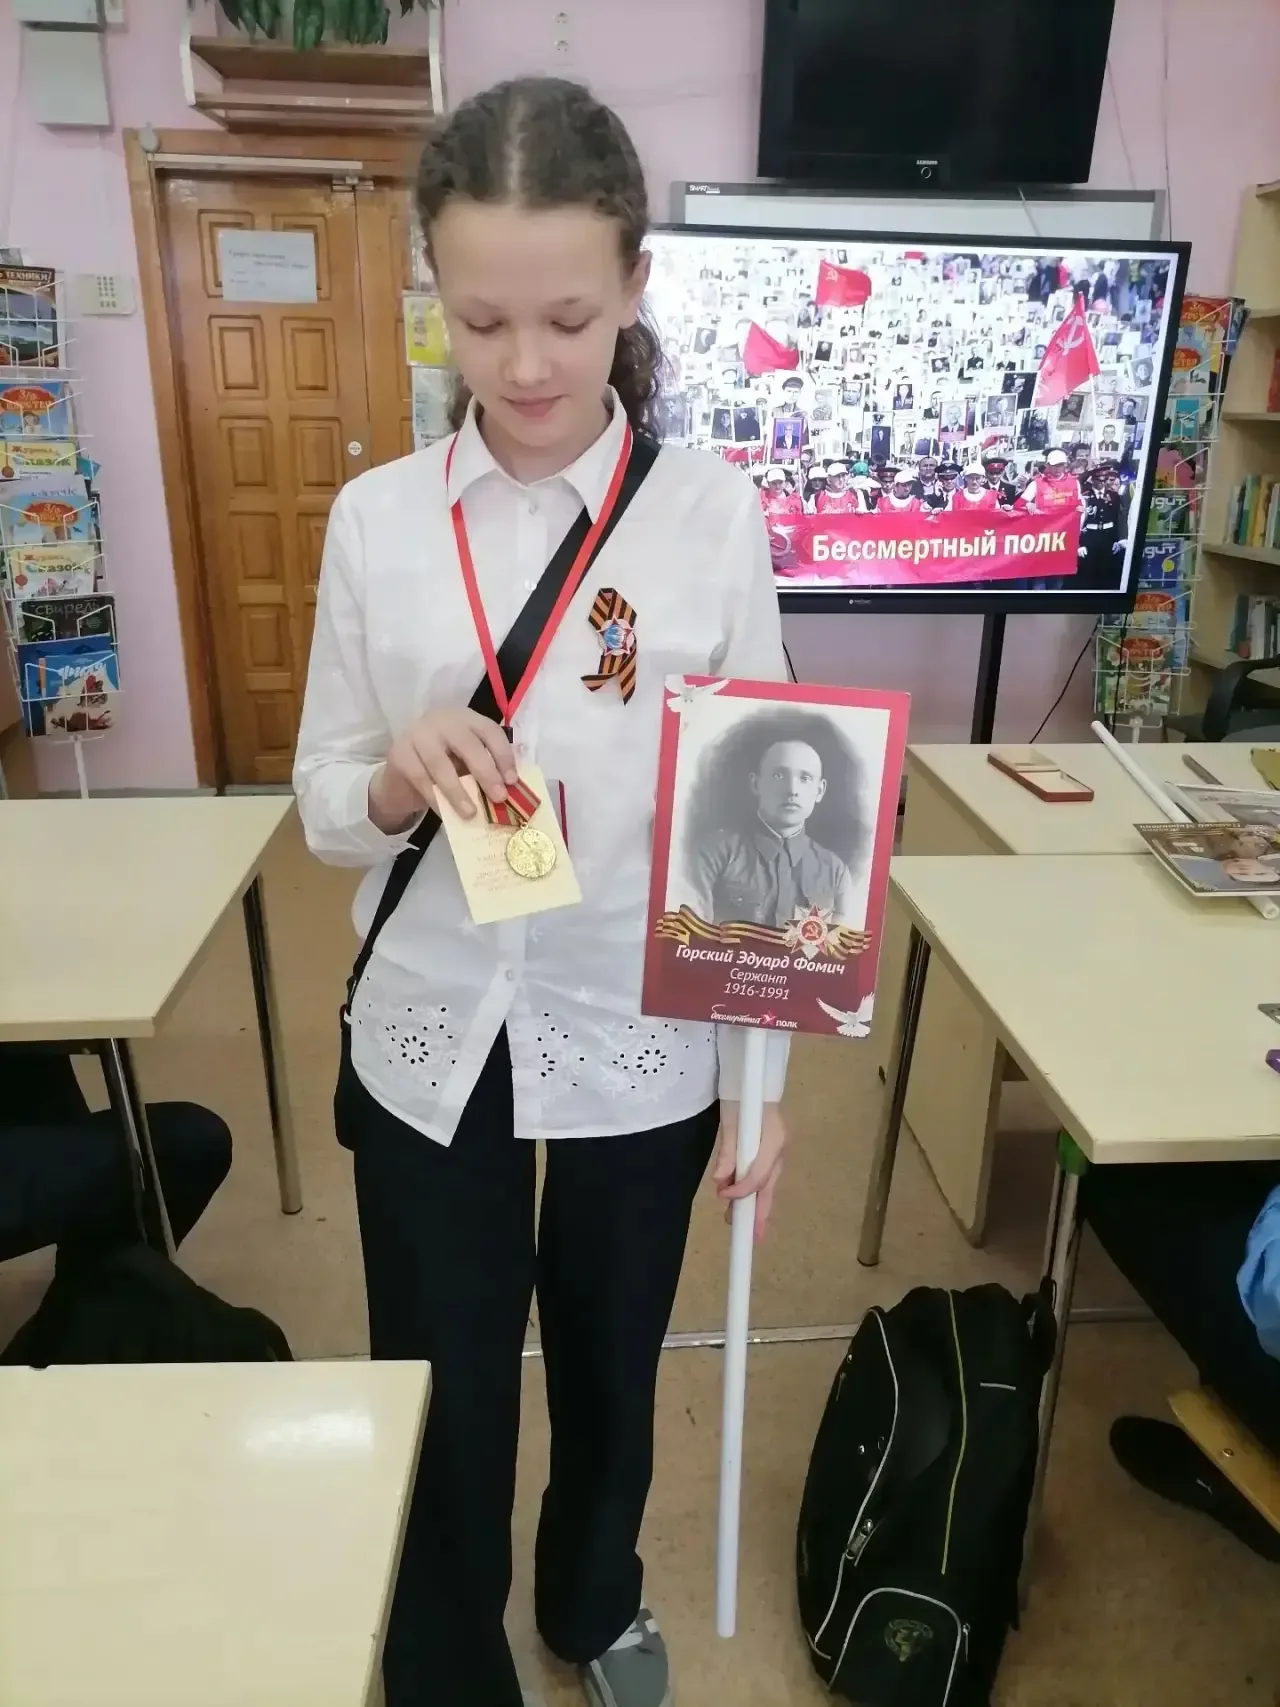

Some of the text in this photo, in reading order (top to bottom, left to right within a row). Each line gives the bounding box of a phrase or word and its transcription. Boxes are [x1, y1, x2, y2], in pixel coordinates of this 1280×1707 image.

[812, 530, 1067, 565] Бессмертный полк
[676, 944, 846, 975] Горский Эдуард Фомич
[730, 968, 788, 985] Сержант
[724, 982, 790, 1000] 1916-1991
